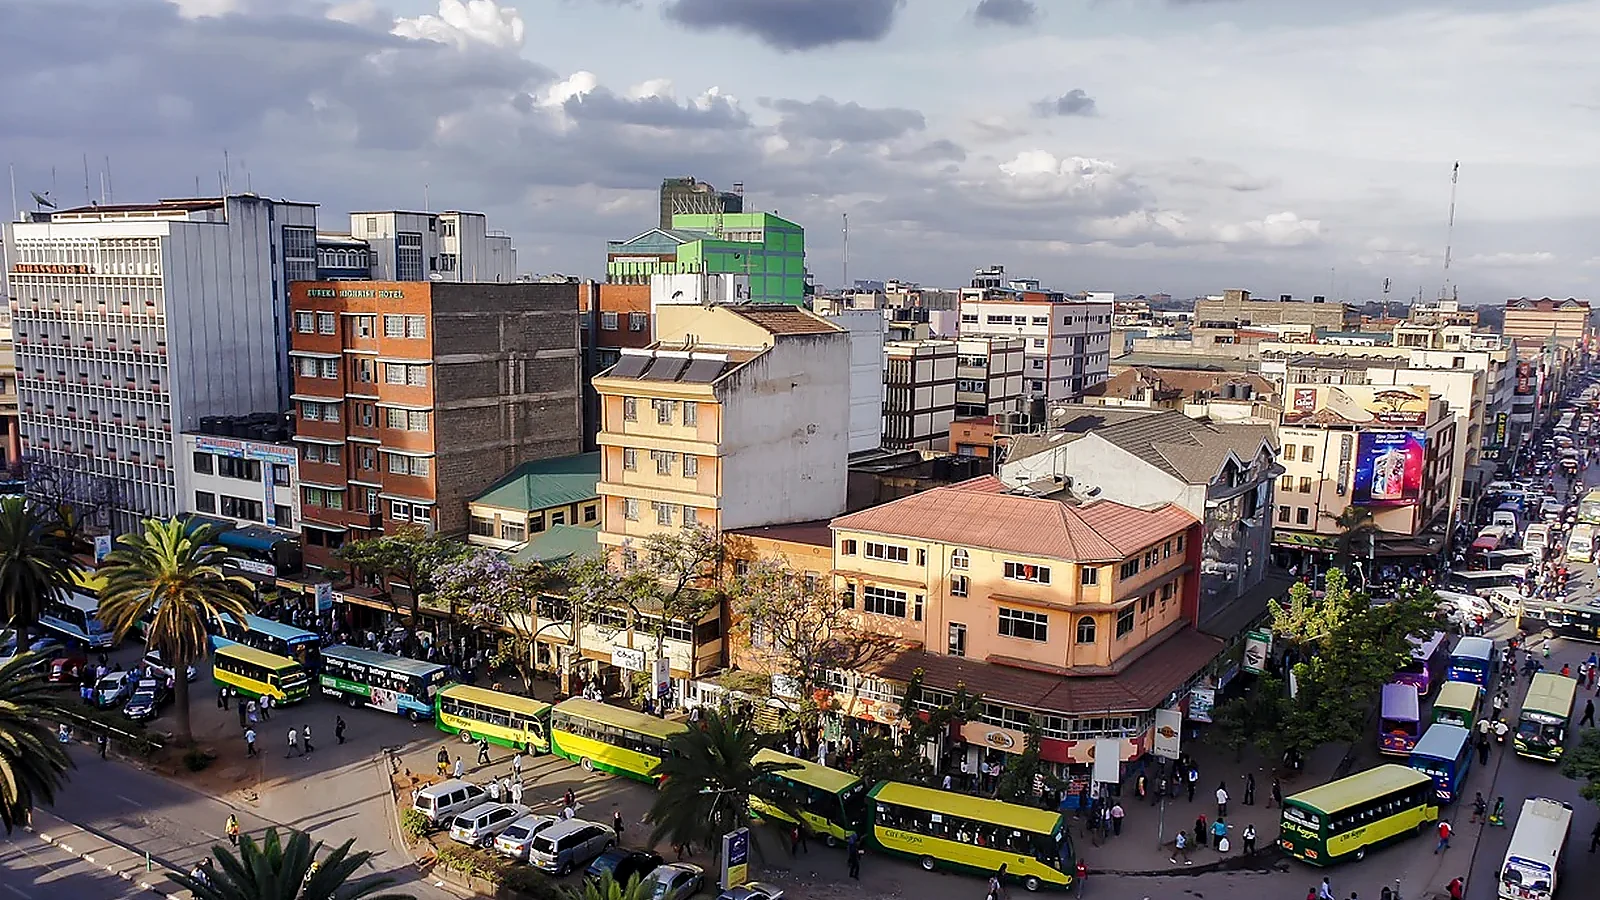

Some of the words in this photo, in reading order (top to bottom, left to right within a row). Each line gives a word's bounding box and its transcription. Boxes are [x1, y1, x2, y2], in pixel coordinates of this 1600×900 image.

[13, 263, 87, 274] AMBASSADER
[307, 289, 336, 298] EUREKA
[378, 290, 404, 299] HOTEL
[326, 657, 344, 668] betway
[348, 662, 365, 673] betway
[369, 667, 387, 678] betway
[391, 671, 409, 682] betway
[322, 687, 342, 698] betway
